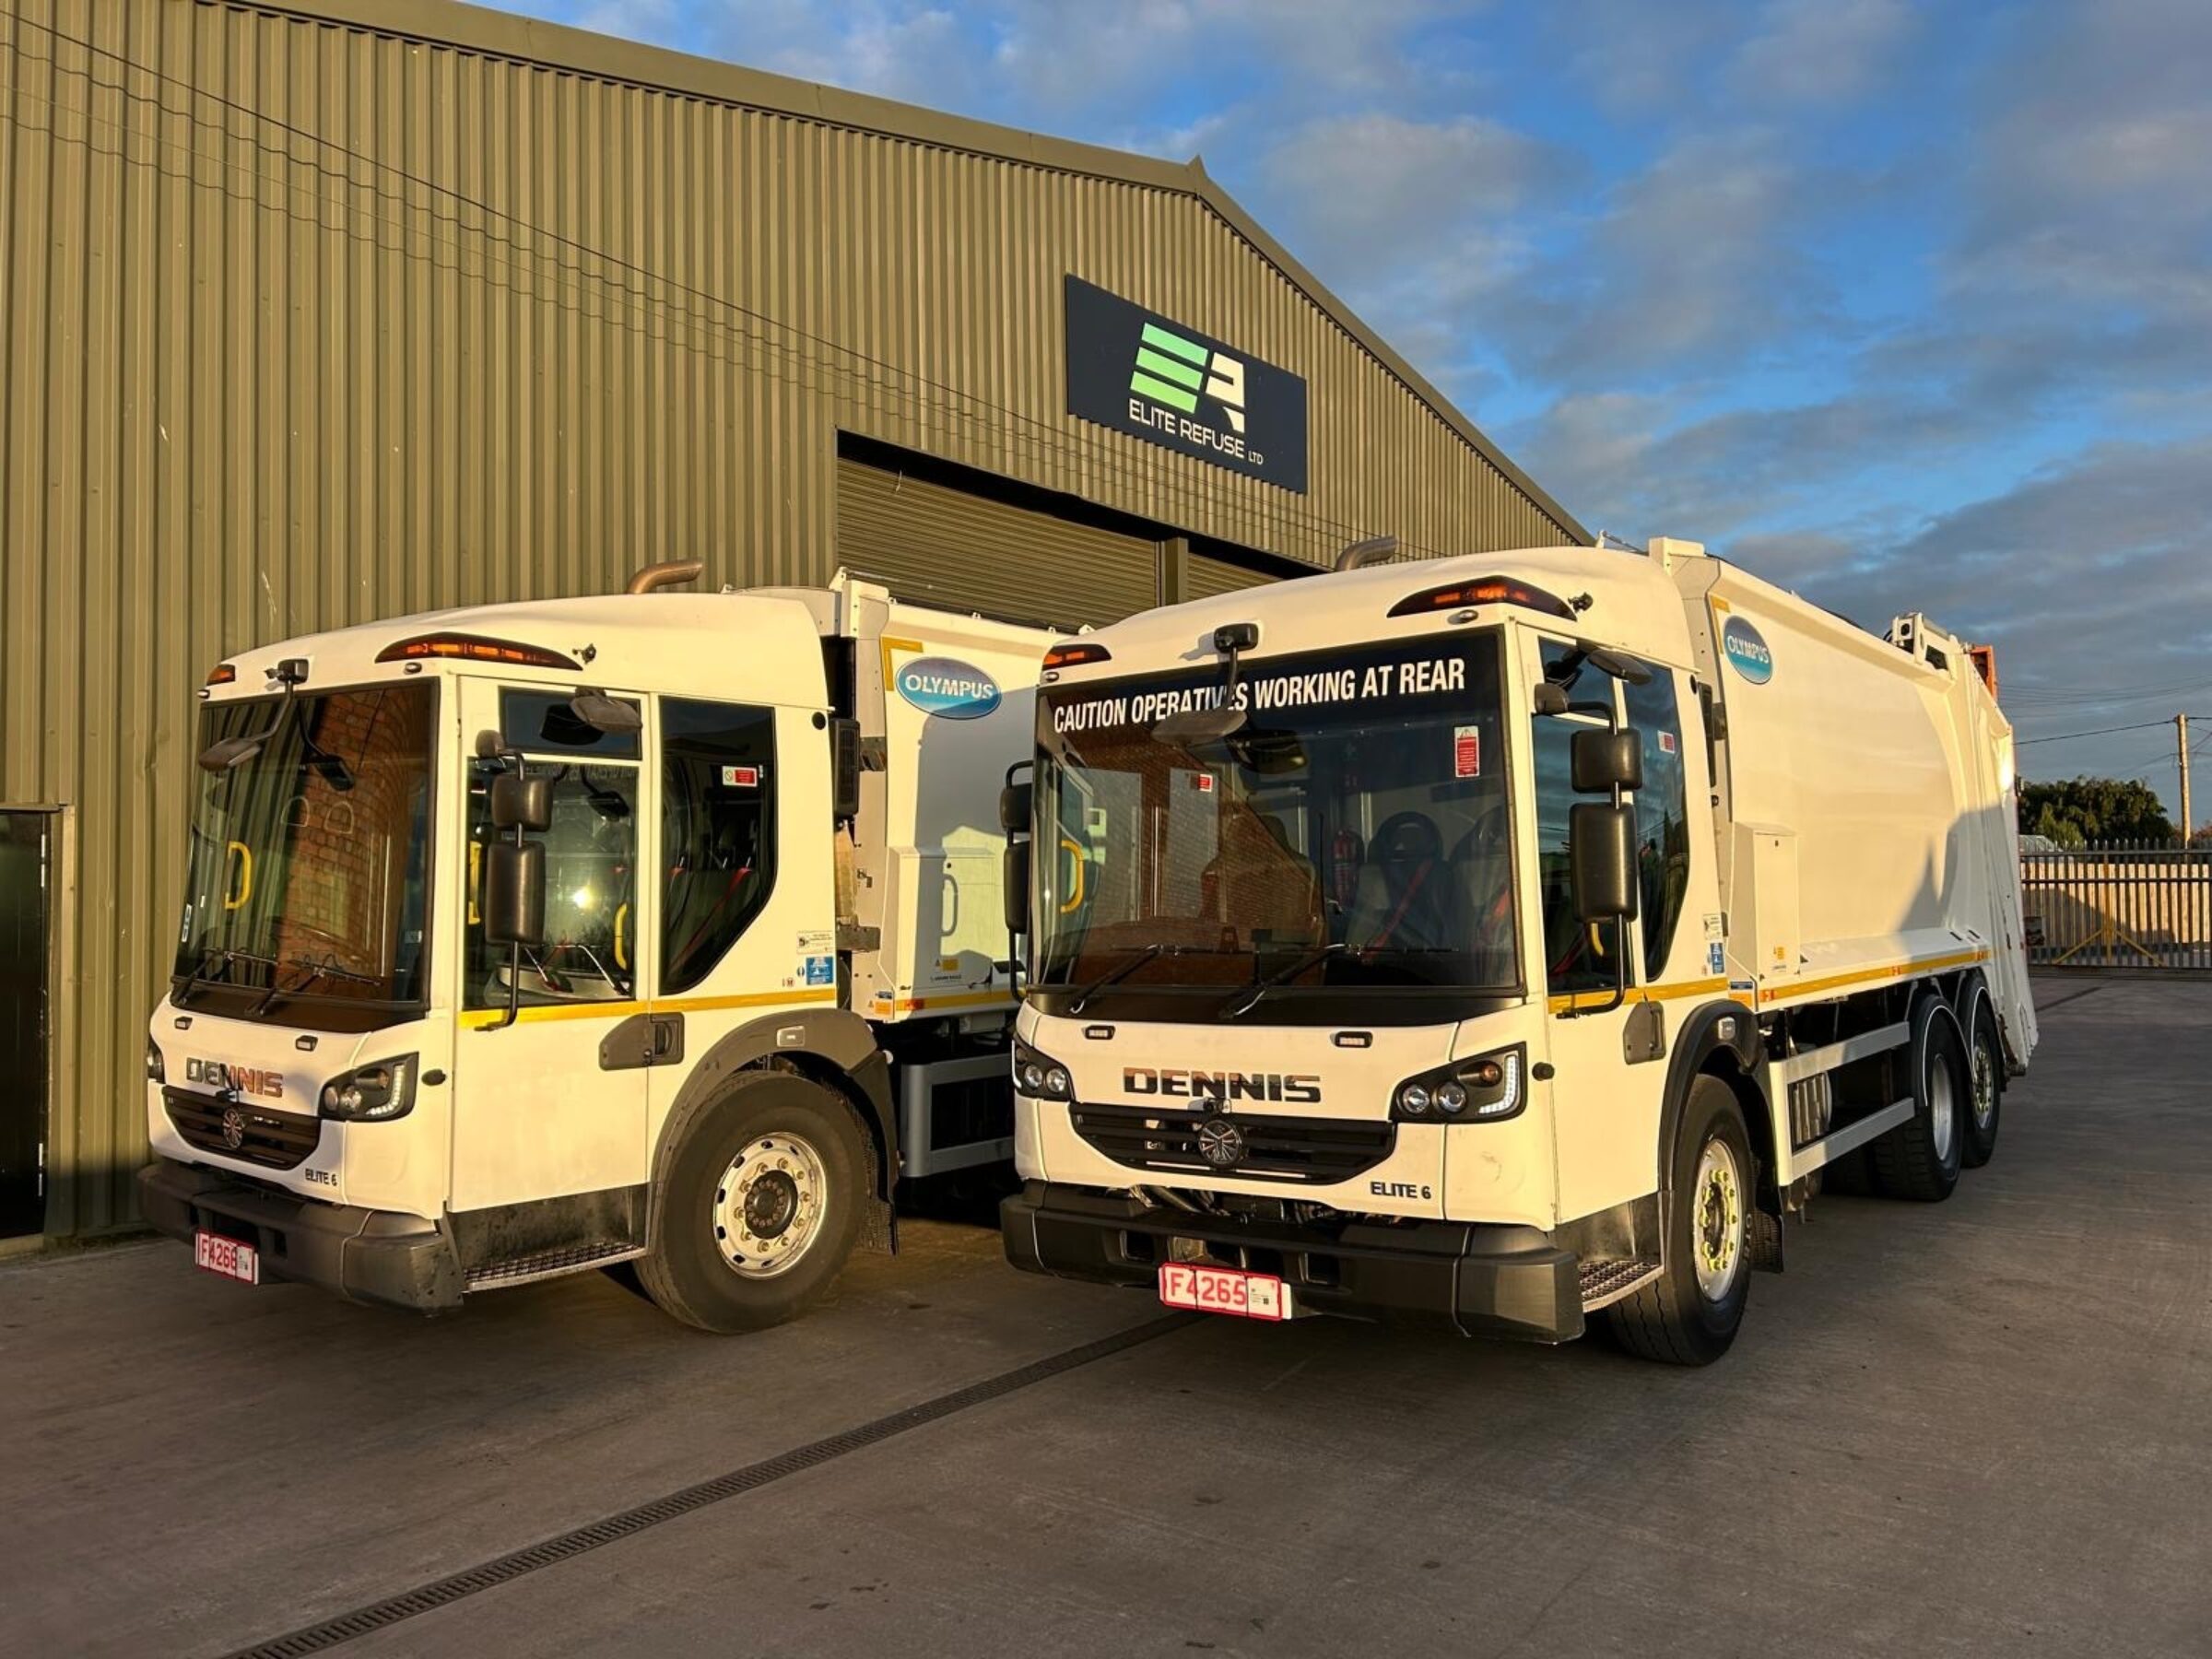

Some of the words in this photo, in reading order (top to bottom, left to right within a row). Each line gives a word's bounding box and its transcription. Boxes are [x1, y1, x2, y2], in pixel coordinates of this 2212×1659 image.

[1129, 397, 1176, 435] ELITE
[1180, 418, 1245, 459] REFUSE
[1248, 450, 1265, 465] LTD
[1726, 634, 1770, 665] OLYMPUS
[904, 674, 994, 700] OLYMPUS
[1053, 697, 1128, 734] CAUTION
[1254, 668, 1356, 710] WORKING
[1361, 665, 1394, 699] AT
[1399, 657, 1465, 695] REAR
[186, 1056, 284, 1099] DENNIS
[1123, 1066, 1322, 1103] DENNIS
[305, 1168, 330, 1185] ELITE
[331, 1172, 338, 1187] 6
[1370, 1181, 1418, 1199] ELITE
[1420, 1185, 1432, 1200] 6
[1170, 1271, 1248, 1306] F4265
